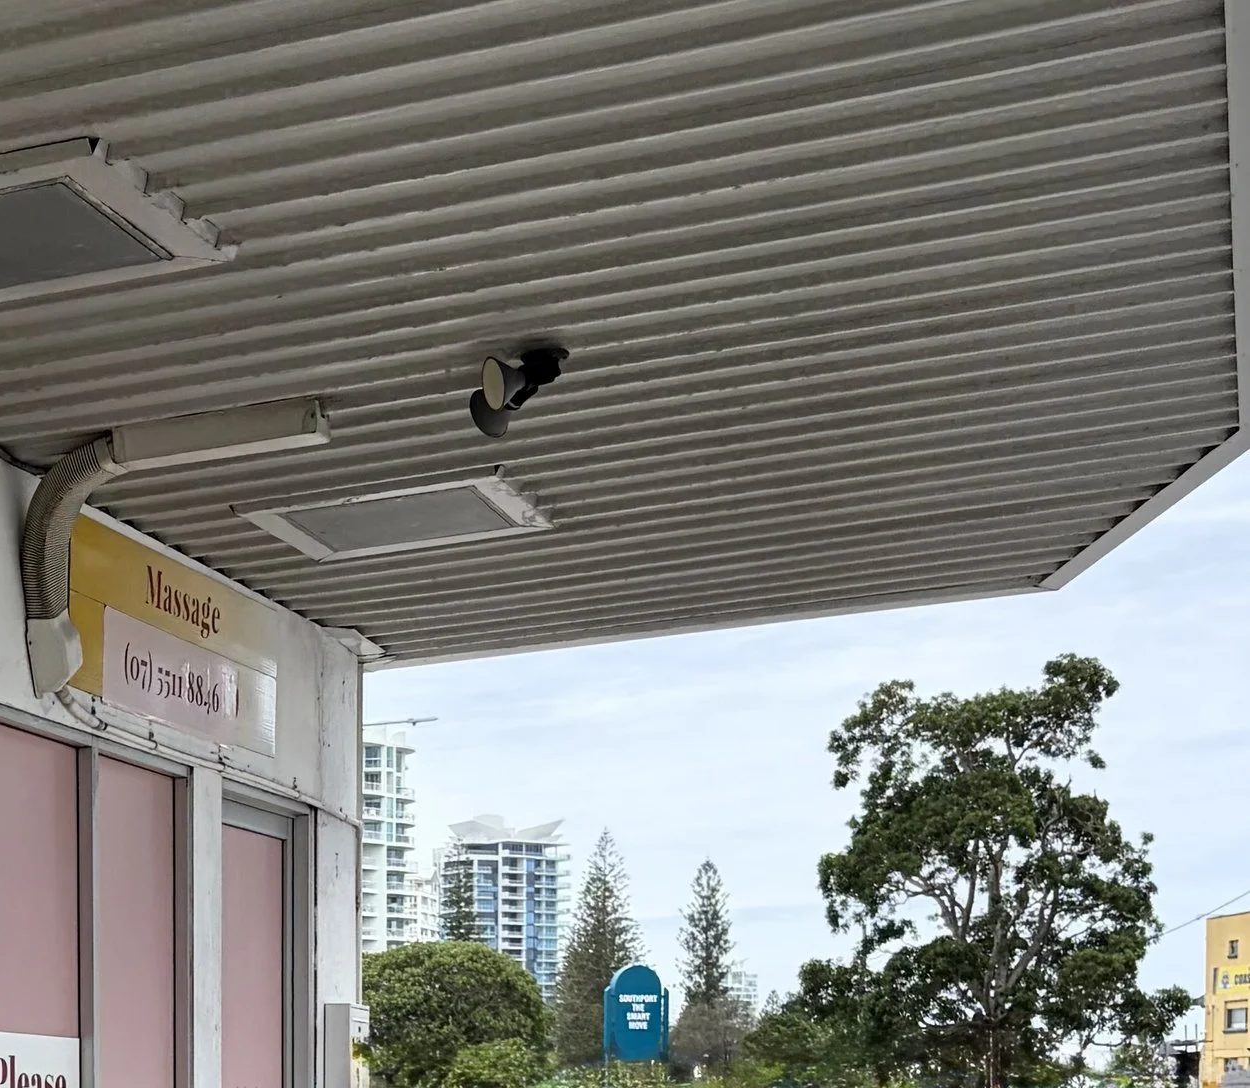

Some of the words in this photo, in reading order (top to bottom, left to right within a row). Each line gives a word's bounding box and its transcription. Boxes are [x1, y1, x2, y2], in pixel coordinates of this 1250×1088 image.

[145, 565, 221, 639] Massage
[124, 642, 152, 693] (07)
[156, 666, 182, 699] 5511
[187, 671, 219, 715] 8846
[618, 994, 658, 1003] SOUTHPORT
[631, 1003, 645, 1012] THE
[626, 1012, 650, 1021] SMART
